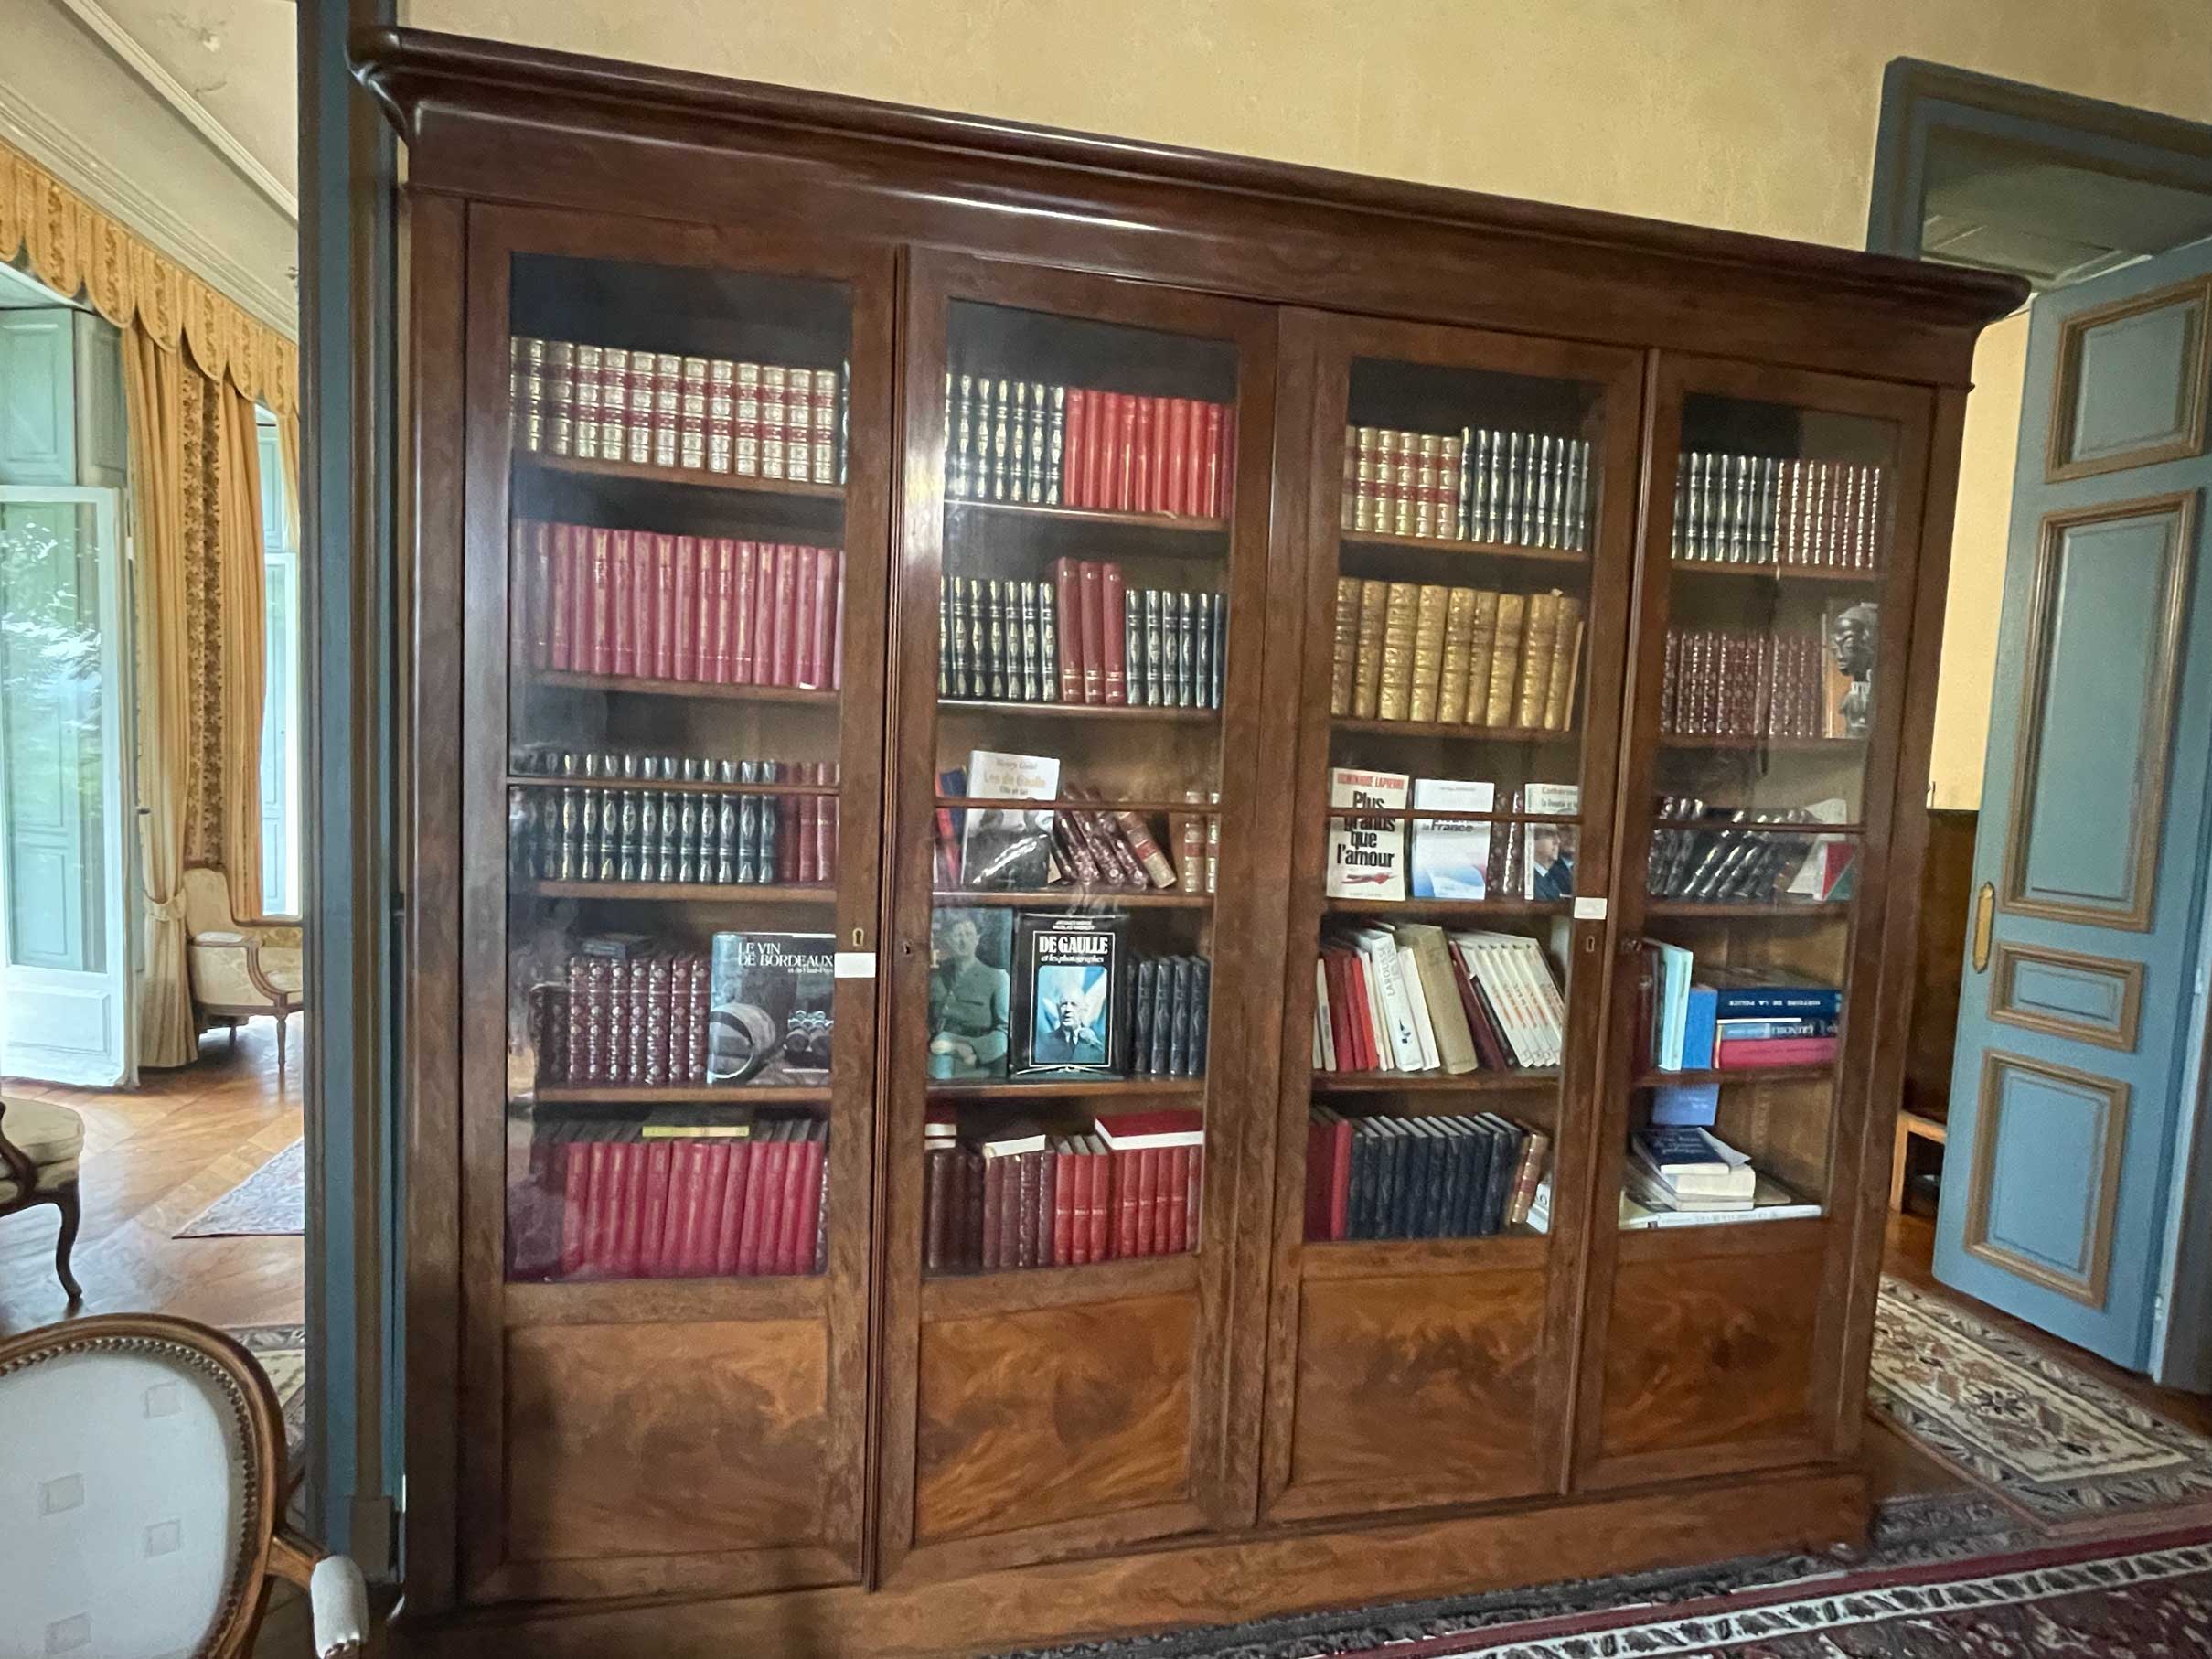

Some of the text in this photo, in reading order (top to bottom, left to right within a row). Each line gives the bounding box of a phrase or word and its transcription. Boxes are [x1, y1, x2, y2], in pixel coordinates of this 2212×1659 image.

[1353, 790, 1385, 809] Plus
[1431, 822, 1473, 832] France
[1351, 830, 1378, 850] que
[1337, 843, 1395, 868] l'amour
[738, 942, 781, 955] LE VIN
[1039, 936, 1108, 954] DE GAULLE
[738, 954, 833, 967] DE BORDEAUX
